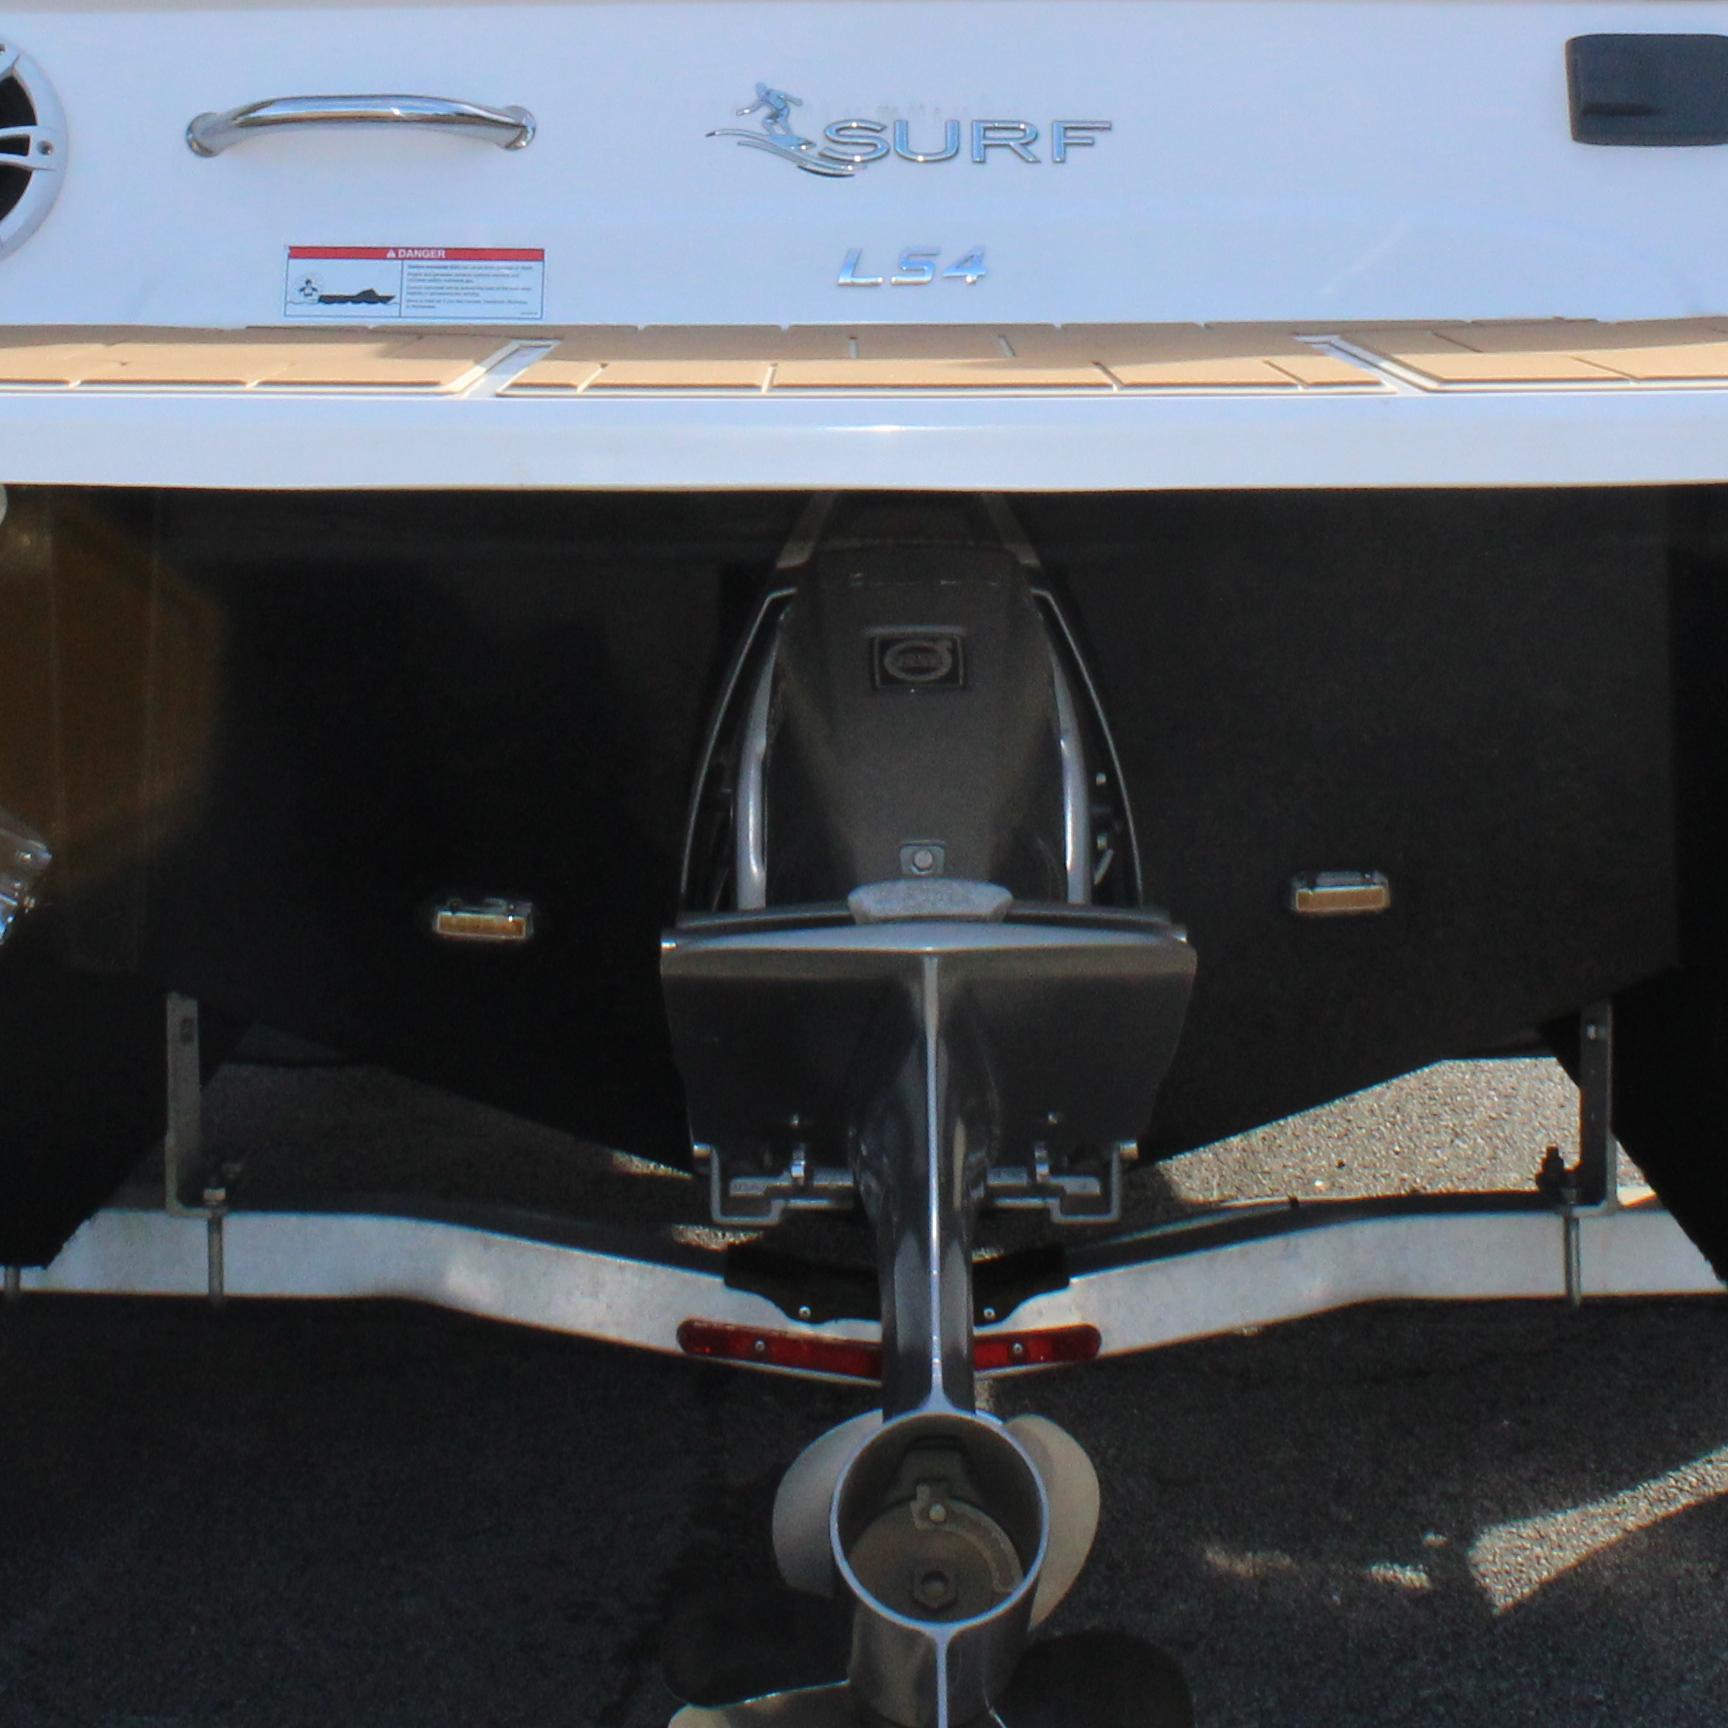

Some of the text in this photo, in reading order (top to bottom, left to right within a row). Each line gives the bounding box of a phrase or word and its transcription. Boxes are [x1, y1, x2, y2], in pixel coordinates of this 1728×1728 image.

[819, 118, 1112, 164] SURF
[398, 248, 446, 259] DANGER
[837, 246, 989, 287] LS4
